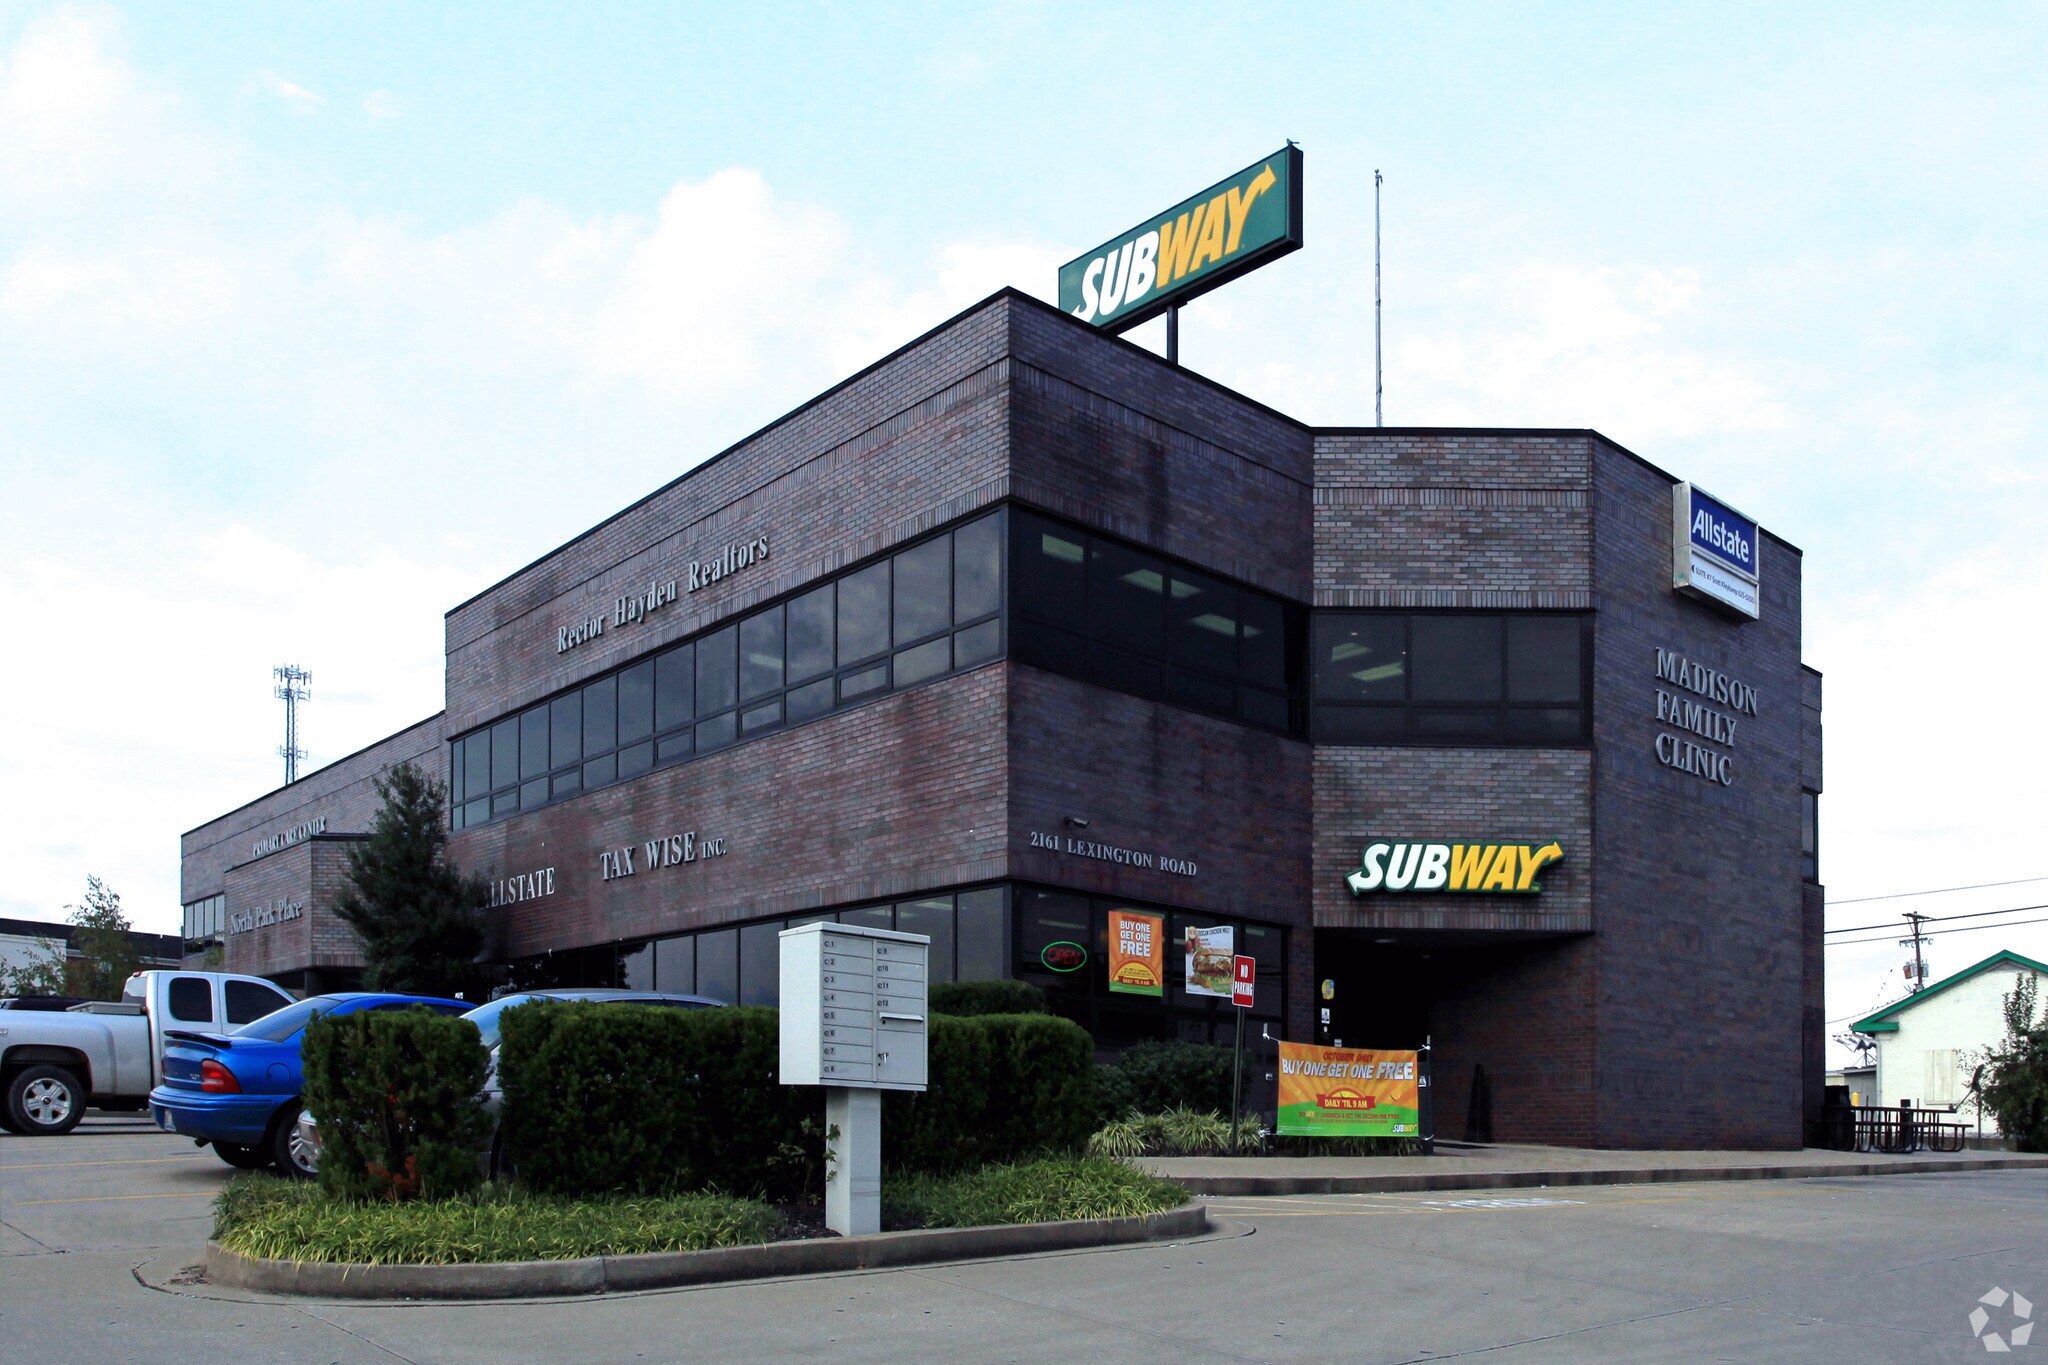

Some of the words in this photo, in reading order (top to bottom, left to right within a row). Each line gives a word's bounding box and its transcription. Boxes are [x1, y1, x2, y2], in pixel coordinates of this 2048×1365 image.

[1071, 164, 1276, 322] SUBWAY
[1692, 509, 1749, 563] Allstate
[557, 613, 605, 654] Rector
[614, 580, 677, 627] Hayden
[688, 535, 768, 592] Realtors
[1656, 647, 1757, 716] MADISON
[1656, 689, 1737, 747] FAMILY
[1655, 732, 1732, 786] CLINIC
[600, 846, 636, 880] TAX
[645, 831, 696, 869] WISE
[702, 838, 727, 859] INC.
[1030, 831, 1059, 850] 2161
[1067, 838, 1152, 868] LEXINGTON
[1160, 856, 1197, 876] ROAD
[1347, 841, 1563, 892] SUBWAY
[482, 867, 554, 908] LLSTATE
[230, 908, 253, 935] North
[256, 901, 275, 928] Park
[278, 896, 302, 922] Place
[1120, 920, 1135, 930] BUY
[1136, 923, 1150, 933] ONE
[1046, 946, 1081, 965] OPEN
[1120, 931, 1134, 940] GET
[1136, 933, 1150, 942] ONE
[1120, 940, 1150, 958] FREE
[1234, 981, 1252, 996] PARKING
[1240, 964, 1248, 978] NO
[1282, 1058, 1304, 1074] BUY
[1304, 1061, 1328, 1076] ONE
[1328, 1063, 1350, 1078] GET
[1350, 1064, 1375, 1079] ONE
[1376, 1062, 1414, 1080] FREE
[1323, 1051, 1354, 1061] OCTOBER
[1356, 1053, 1375, 1062] ONLY
[1324, 1099, 1342, 1108] DAILY
[1353, 1100, 1357, 1108] 9
[1358, 1100, 1368, 1108] AM
[1392, 1124, 1417, 1133] SUBWAY
